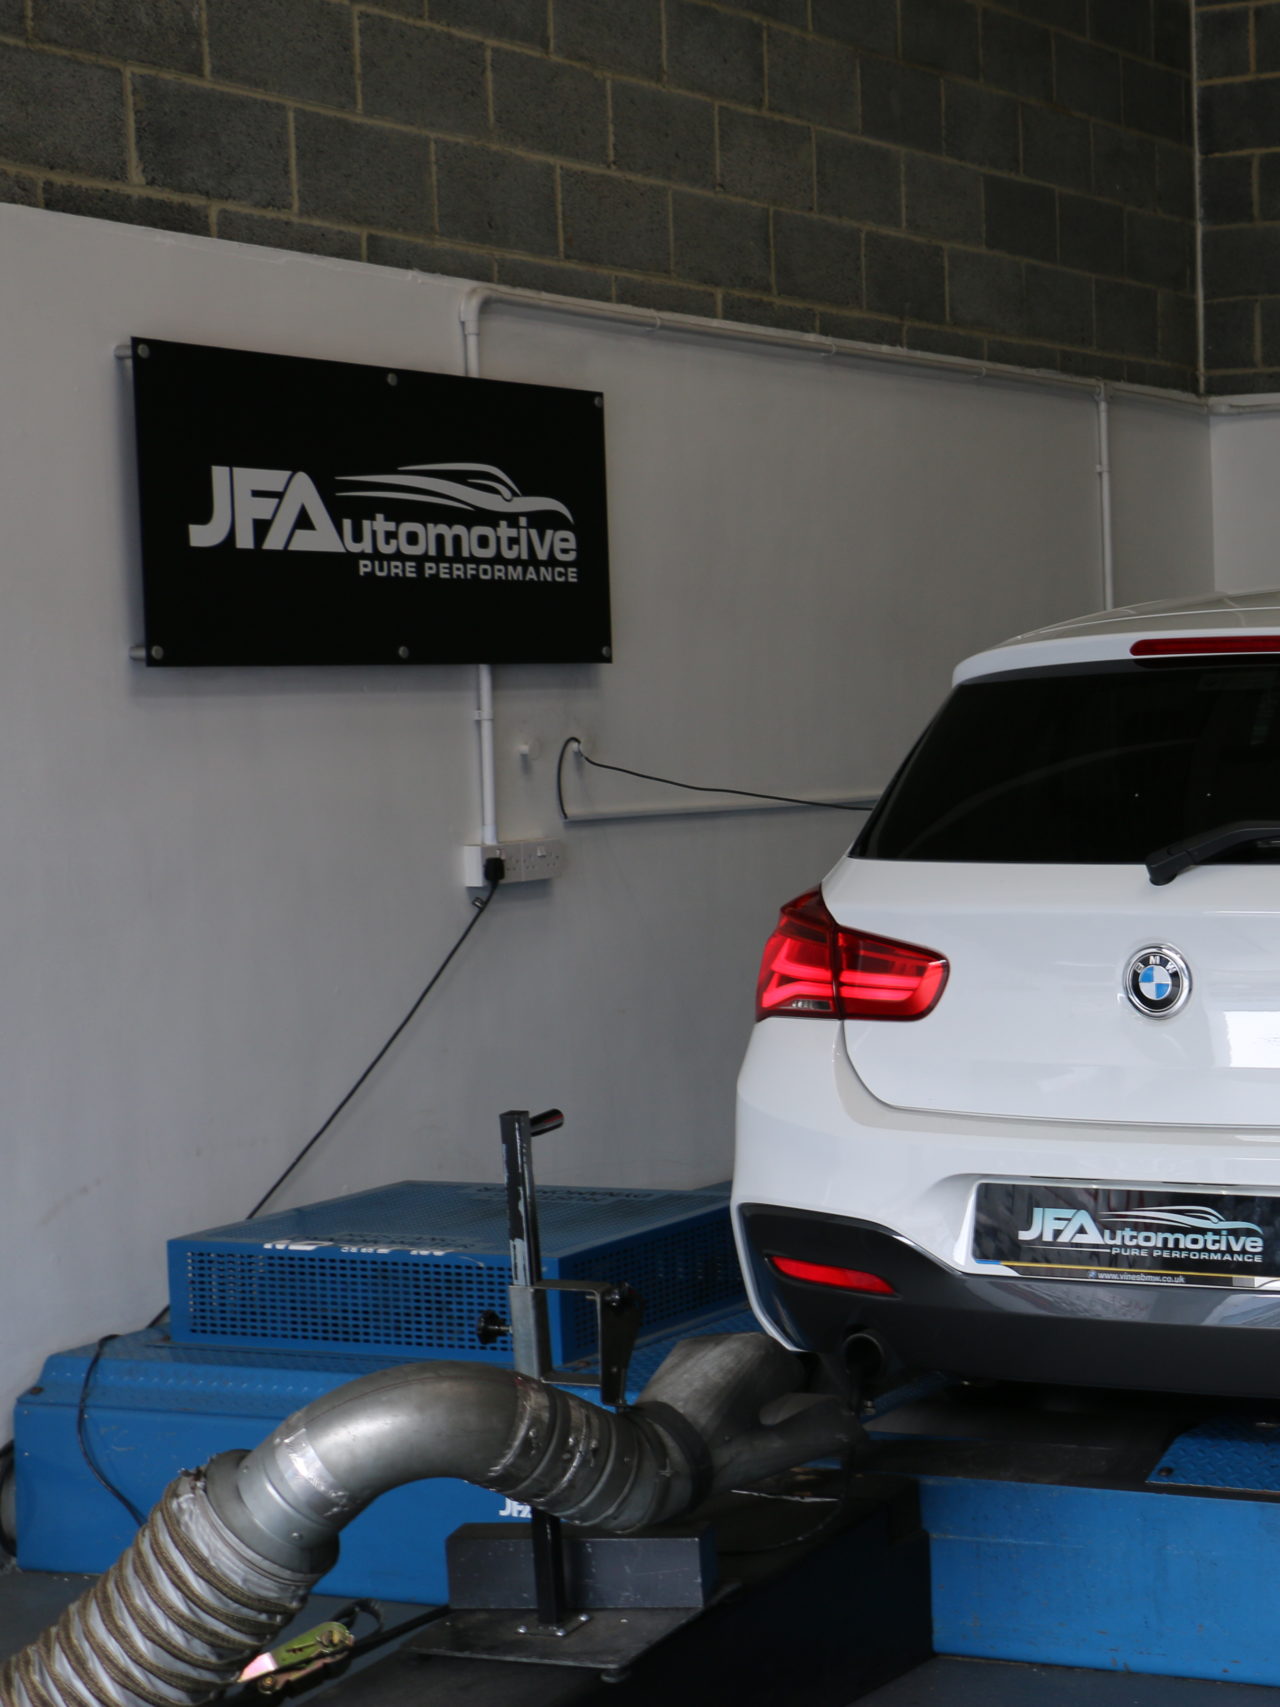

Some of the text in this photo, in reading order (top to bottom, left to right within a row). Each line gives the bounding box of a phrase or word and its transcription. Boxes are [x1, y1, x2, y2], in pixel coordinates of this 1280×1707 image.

[189, 465, 577, 561] JFAutomotive
[358, 559, 579, 583] PURE PERFORMANCE
[1134, 955, 1177, 974] BMW
[1018, 1207, 1264, 1253] JFAutomotive
[1111, 1247, 1263, 1263] PURE PERFORMANCE
[1097, 1271, 1185, 1283] www.vinesbmw.co.uk
